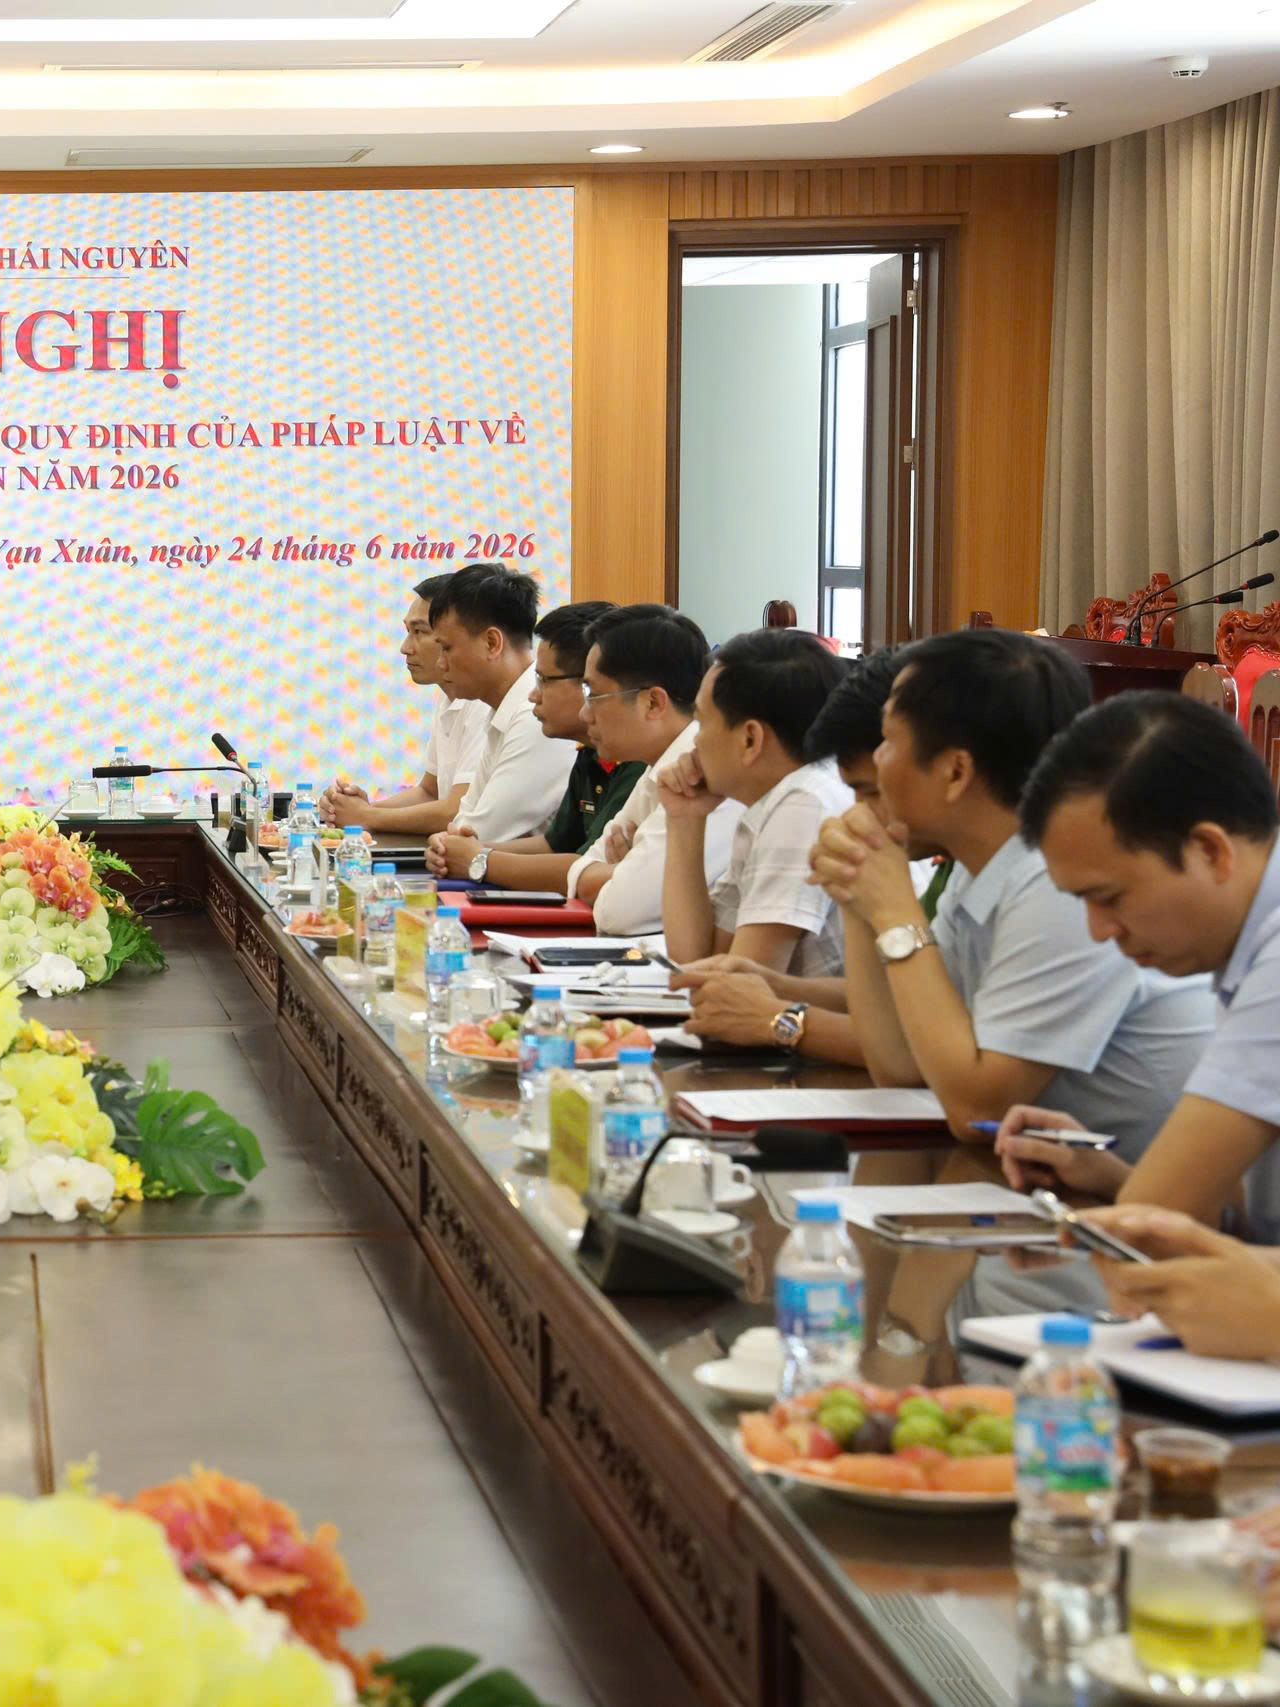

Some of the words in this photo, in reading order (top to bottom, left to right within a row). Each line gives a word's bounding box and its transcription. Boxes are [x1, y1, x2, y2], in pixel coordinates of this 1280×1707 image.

[59, 240, 190, 270] NGUYÊN
[0, 423, 79, 455] QUY
[86, 423, 177, 456] ĐỊNH
[187, 415, 263, 449] CỦA
[271, 414, 365, 447] PHÁP
[373, 417, 470, 453] LUẬT
[478, 411, 527, 445] VỀ
[18, 459, 100, 491] NĂM
[109, 463, 180, 490] 2026
[49, 537, 139, 568] Xuân,
[148, 536, 221, 569] ngày
[227, 536, 263, 562] 24
[271, 535, 357, 567] tháng
[365, 534, 383, 560] 6
[390, 534, 456, 560] năm
[464, 532, 536, 559] 2026
